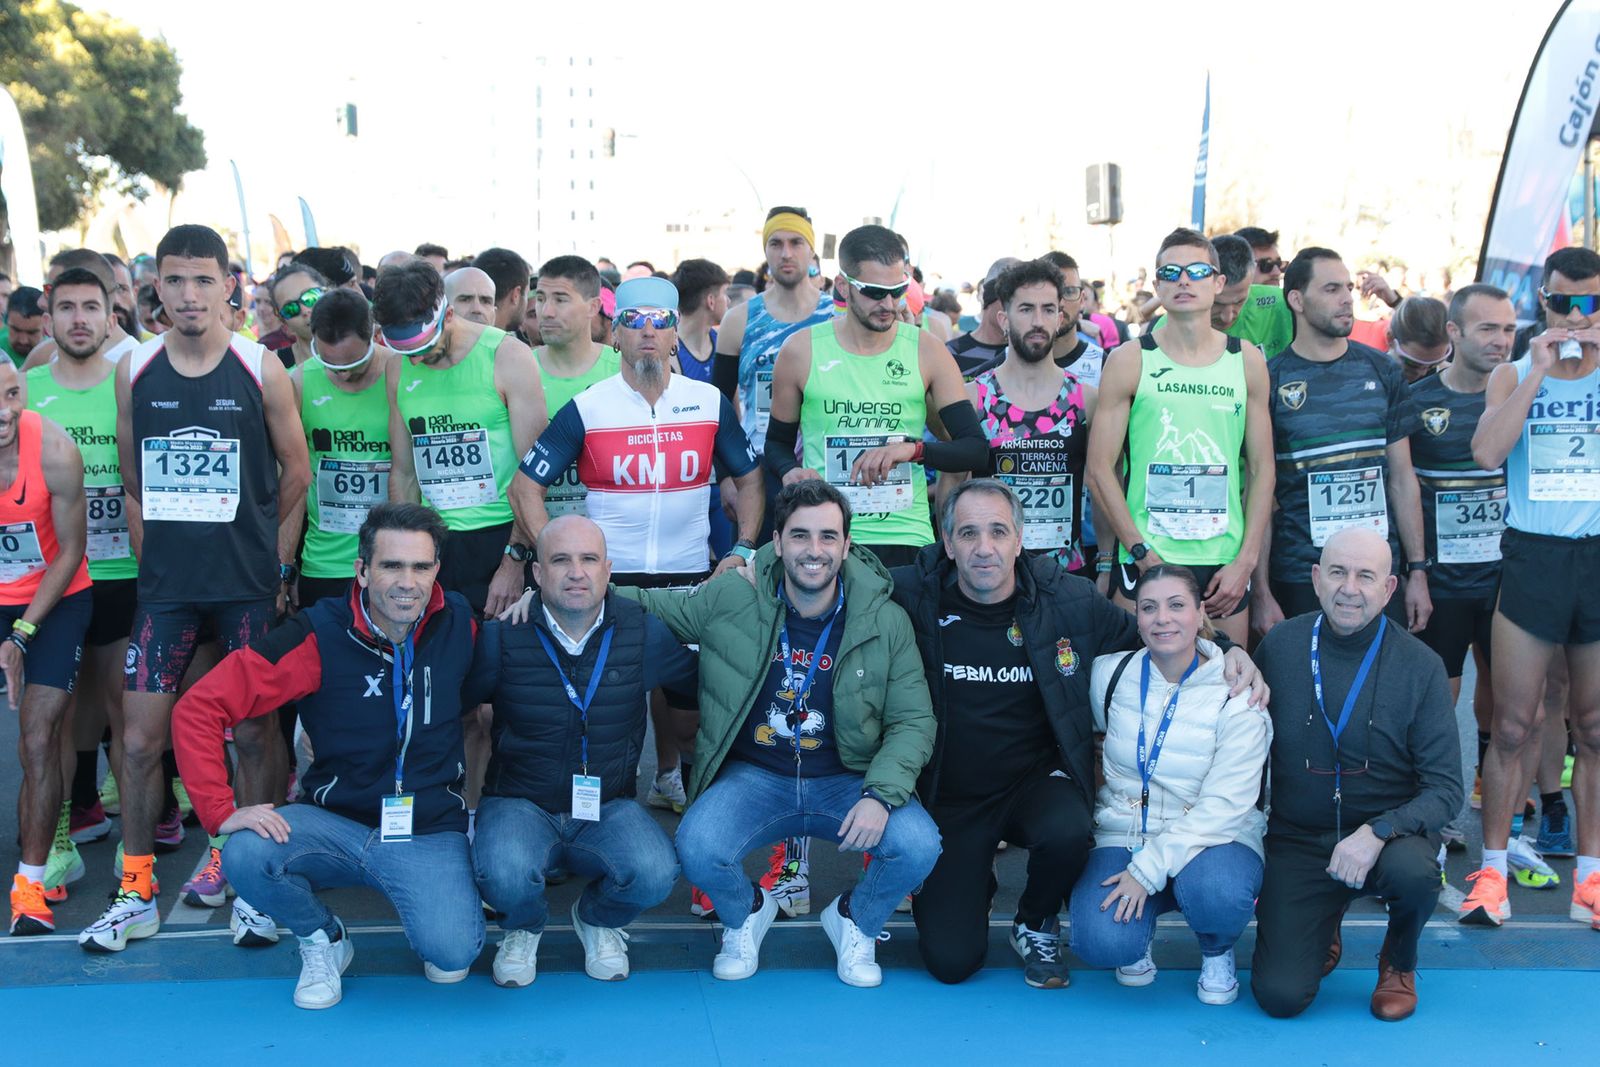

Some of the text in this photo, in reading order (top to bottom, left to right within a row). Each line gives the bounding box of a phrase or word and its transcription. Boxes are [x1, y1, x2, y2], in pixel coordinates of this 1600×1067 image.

[1559, 59, 1599, 149] Cajón
[1256, 295, 1277, 306] 2023
[1157, 382, 1235, 398] LASANSI.COM
[824, 399, 902, 415] Universo
[429, 414, 453, 429] pan
[837, 416, 901, 432] Running
[334, 429, 365, 444] pan
[627, 431, 684, 446] BICICLETAS
[1001, 440, 1065, 450] ARMENTEROS
[1569, 436, 1585, 457] 2
[156, 452, 231, 477] 1324
[421, 444, 483, 469] 1488
[1021, 452, 1069, 461] TIERRAS DE
[613, 452, 666, 486] KM
[1020, 461, 1068, 473] CANENA
[334, 473, 380, 494] 691
[1184, 477, 1195, 498] 1
[1320, 481, 1378, 506] 1257
[1456, 502, 1503, 524] 343
